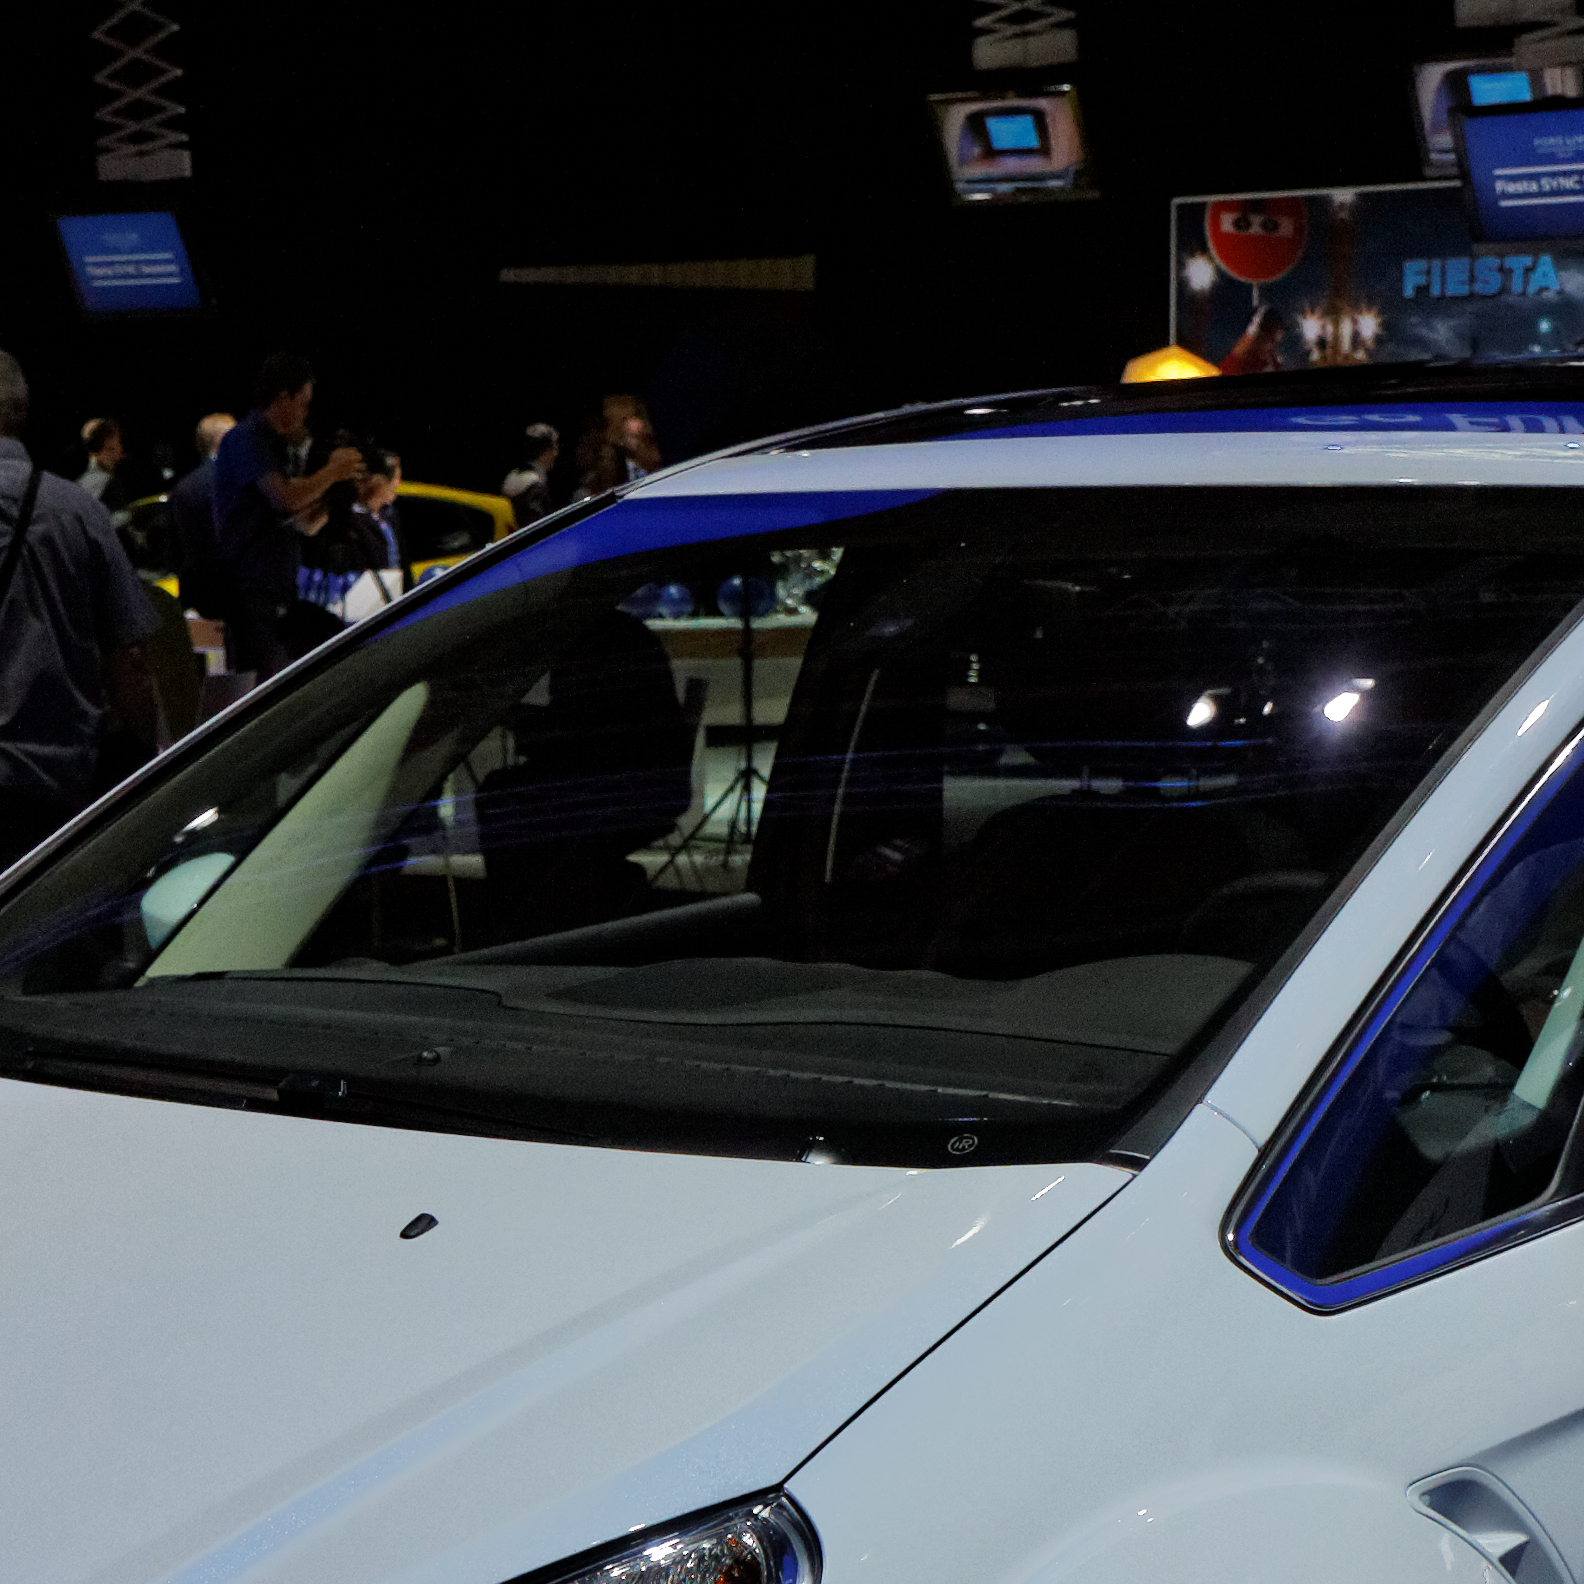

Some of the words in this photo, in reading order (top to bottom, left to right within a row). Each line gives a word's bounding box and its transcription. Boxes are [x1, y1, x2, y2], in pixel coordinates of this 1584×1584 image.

[1494, 179, 1539, 196] Fiesta
[1540, 174, 1582, 193] SYNC
[1402, 253, 1559, 299] FIESTA
